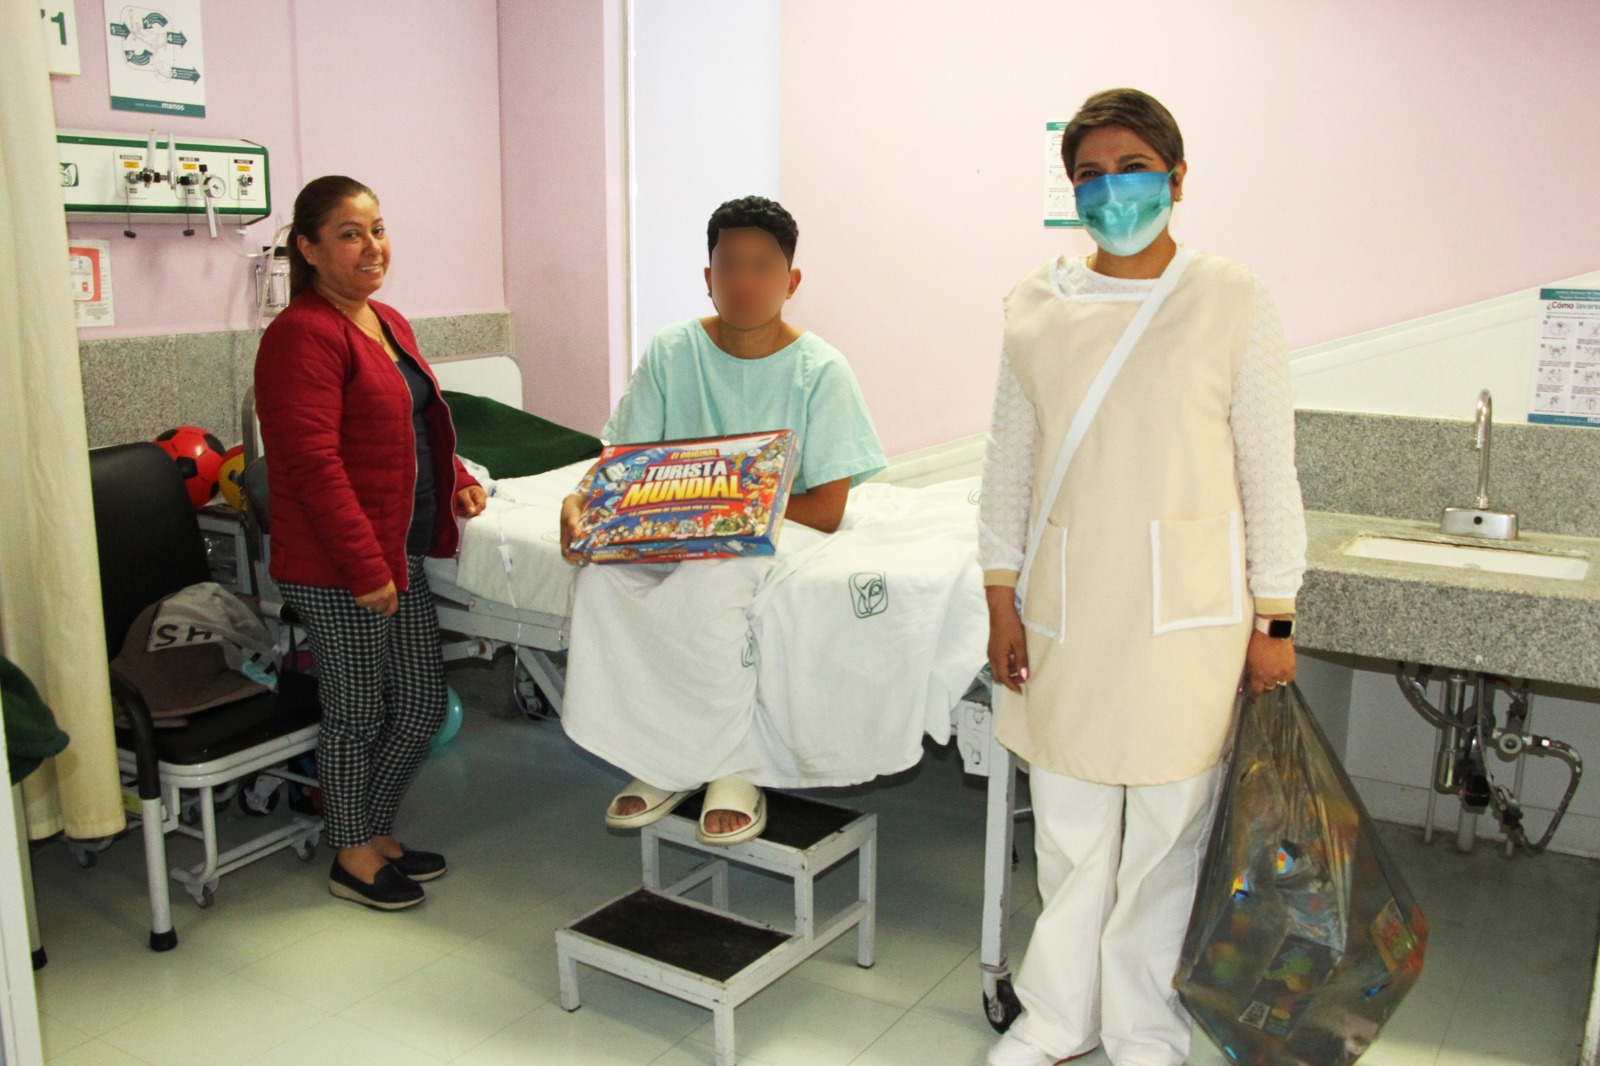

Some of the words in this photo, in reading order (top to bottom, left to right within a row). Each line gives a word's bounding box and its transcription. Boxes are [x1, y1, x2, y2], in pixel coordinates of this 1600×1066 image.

[167, 34, 173, 43] 4
[172, 69, 178, 78] 5
[161, 102, 185, 111] manos
[1546, 301, 1574, 311] ¿Cómo
[680, 449, 717, 459] ORIGINAL
[645, 460, 728, 482] TURISTA
[620, 475, 744, 509] MUNDIAL
